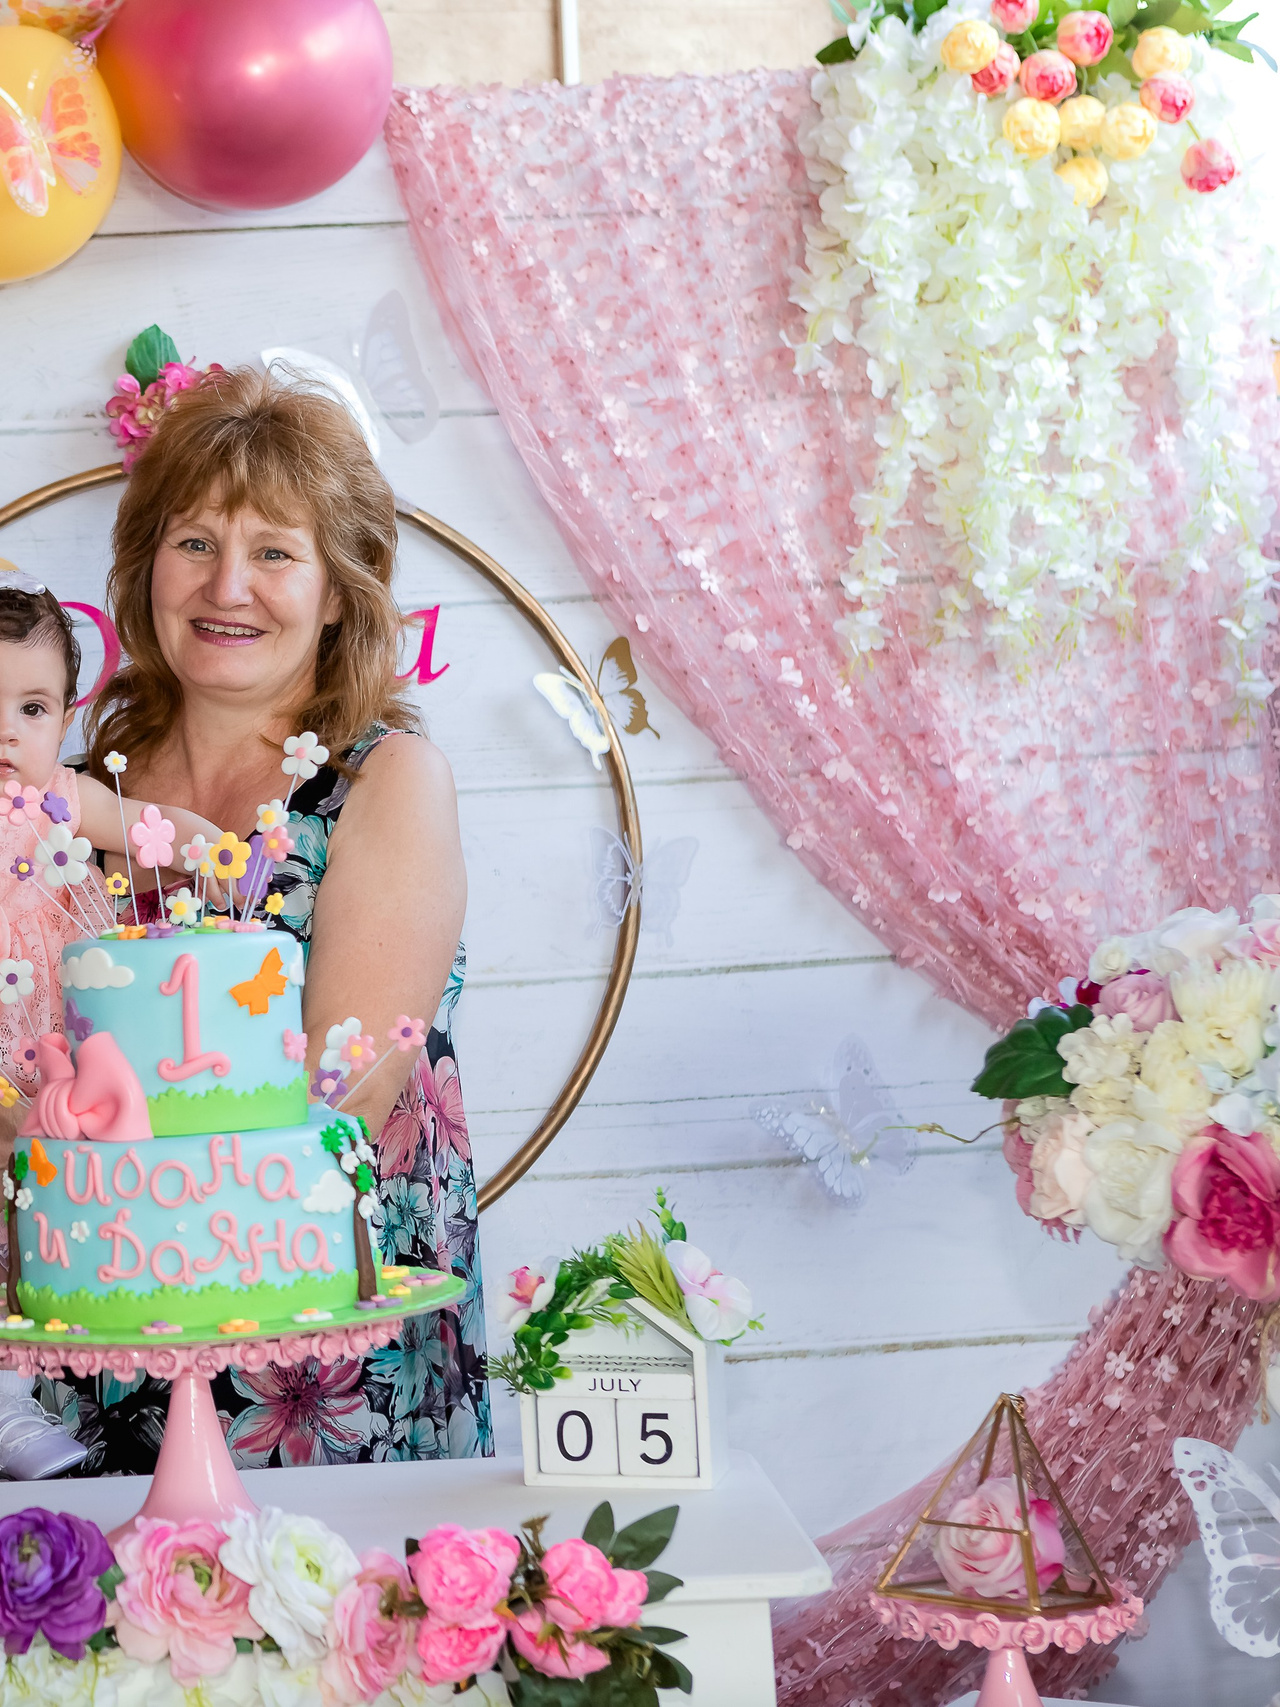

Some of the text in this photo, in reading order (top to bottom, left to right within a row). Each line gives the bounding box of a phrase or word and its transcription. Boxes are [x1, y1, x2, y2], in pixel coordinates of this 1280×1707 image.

[157, 953, 231, 1083] 1
[63, 1134, 301, 1209] Йоана
[588, 1378, 642, 1392] JULY
